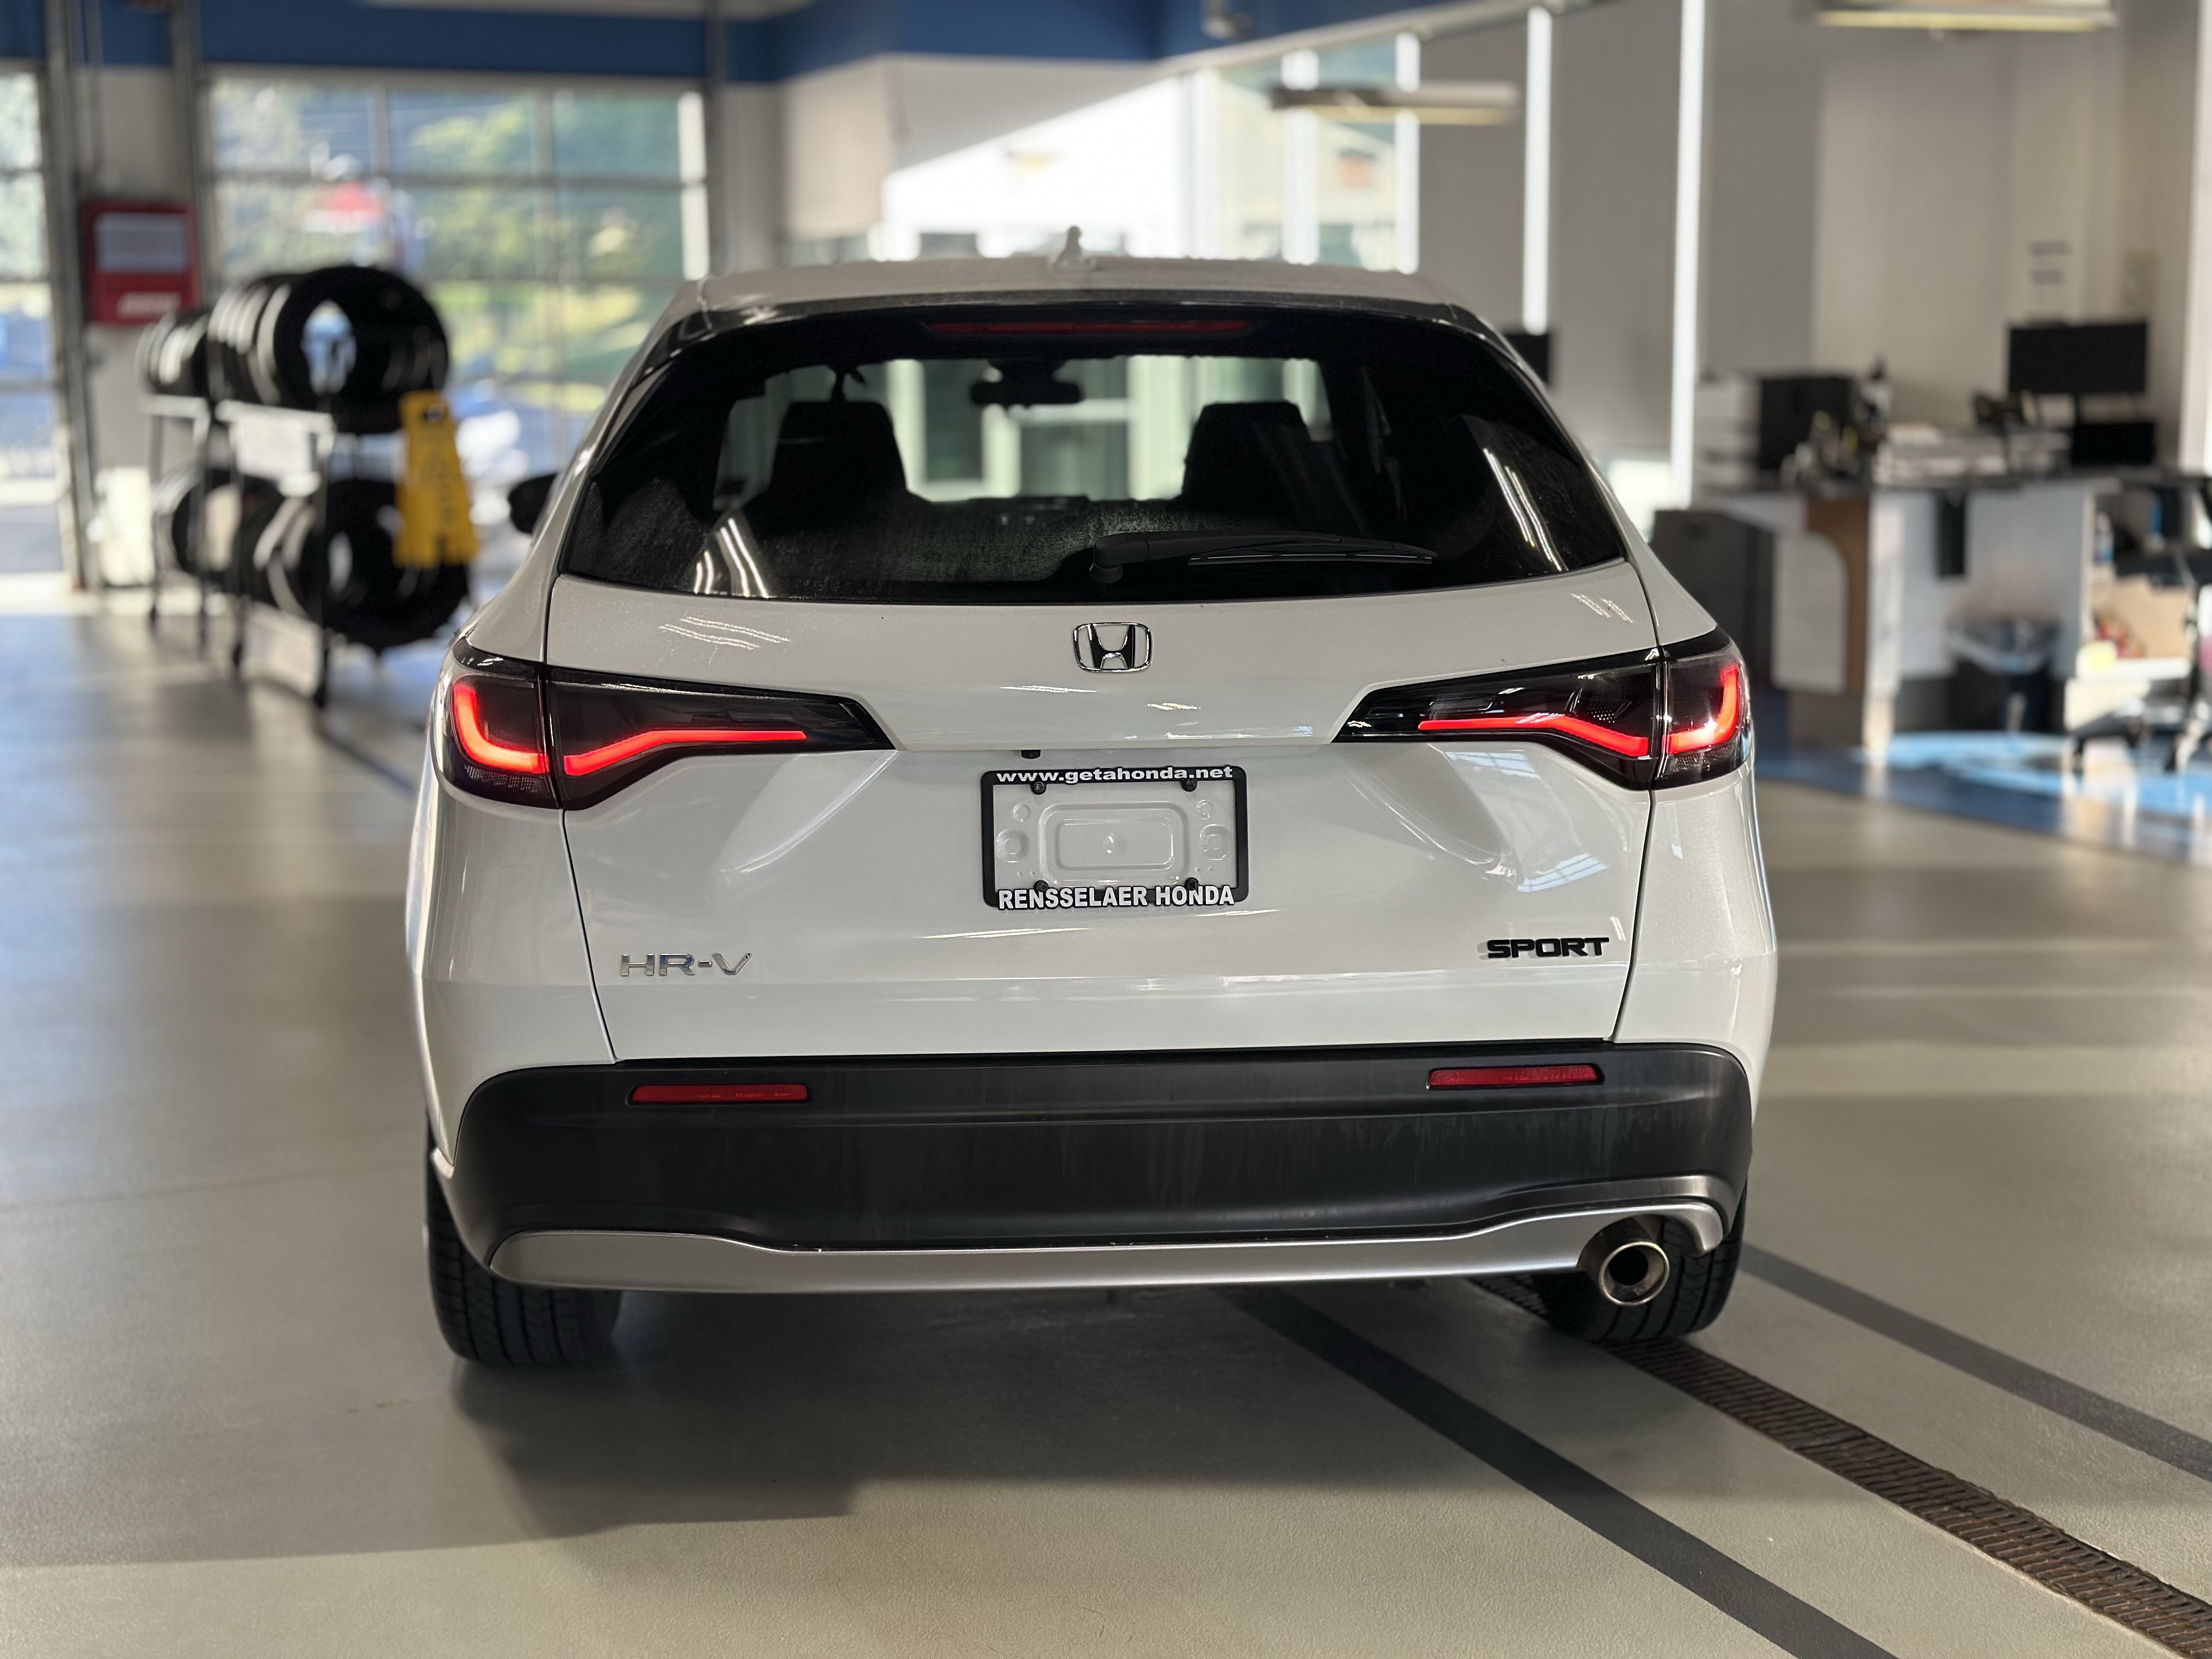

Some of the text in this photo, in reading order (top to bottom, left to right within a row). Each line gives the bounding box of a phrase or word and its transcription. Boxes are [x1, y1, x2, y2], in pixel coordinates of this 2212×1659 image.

[996, 766, 1233, 783] www.getahonda.net
[999, 886, 1234, 909] RENSSELAER HONDA
[1487, 937, 1610, 958] SPORT
[620, 952, 753, 977] HR-V
